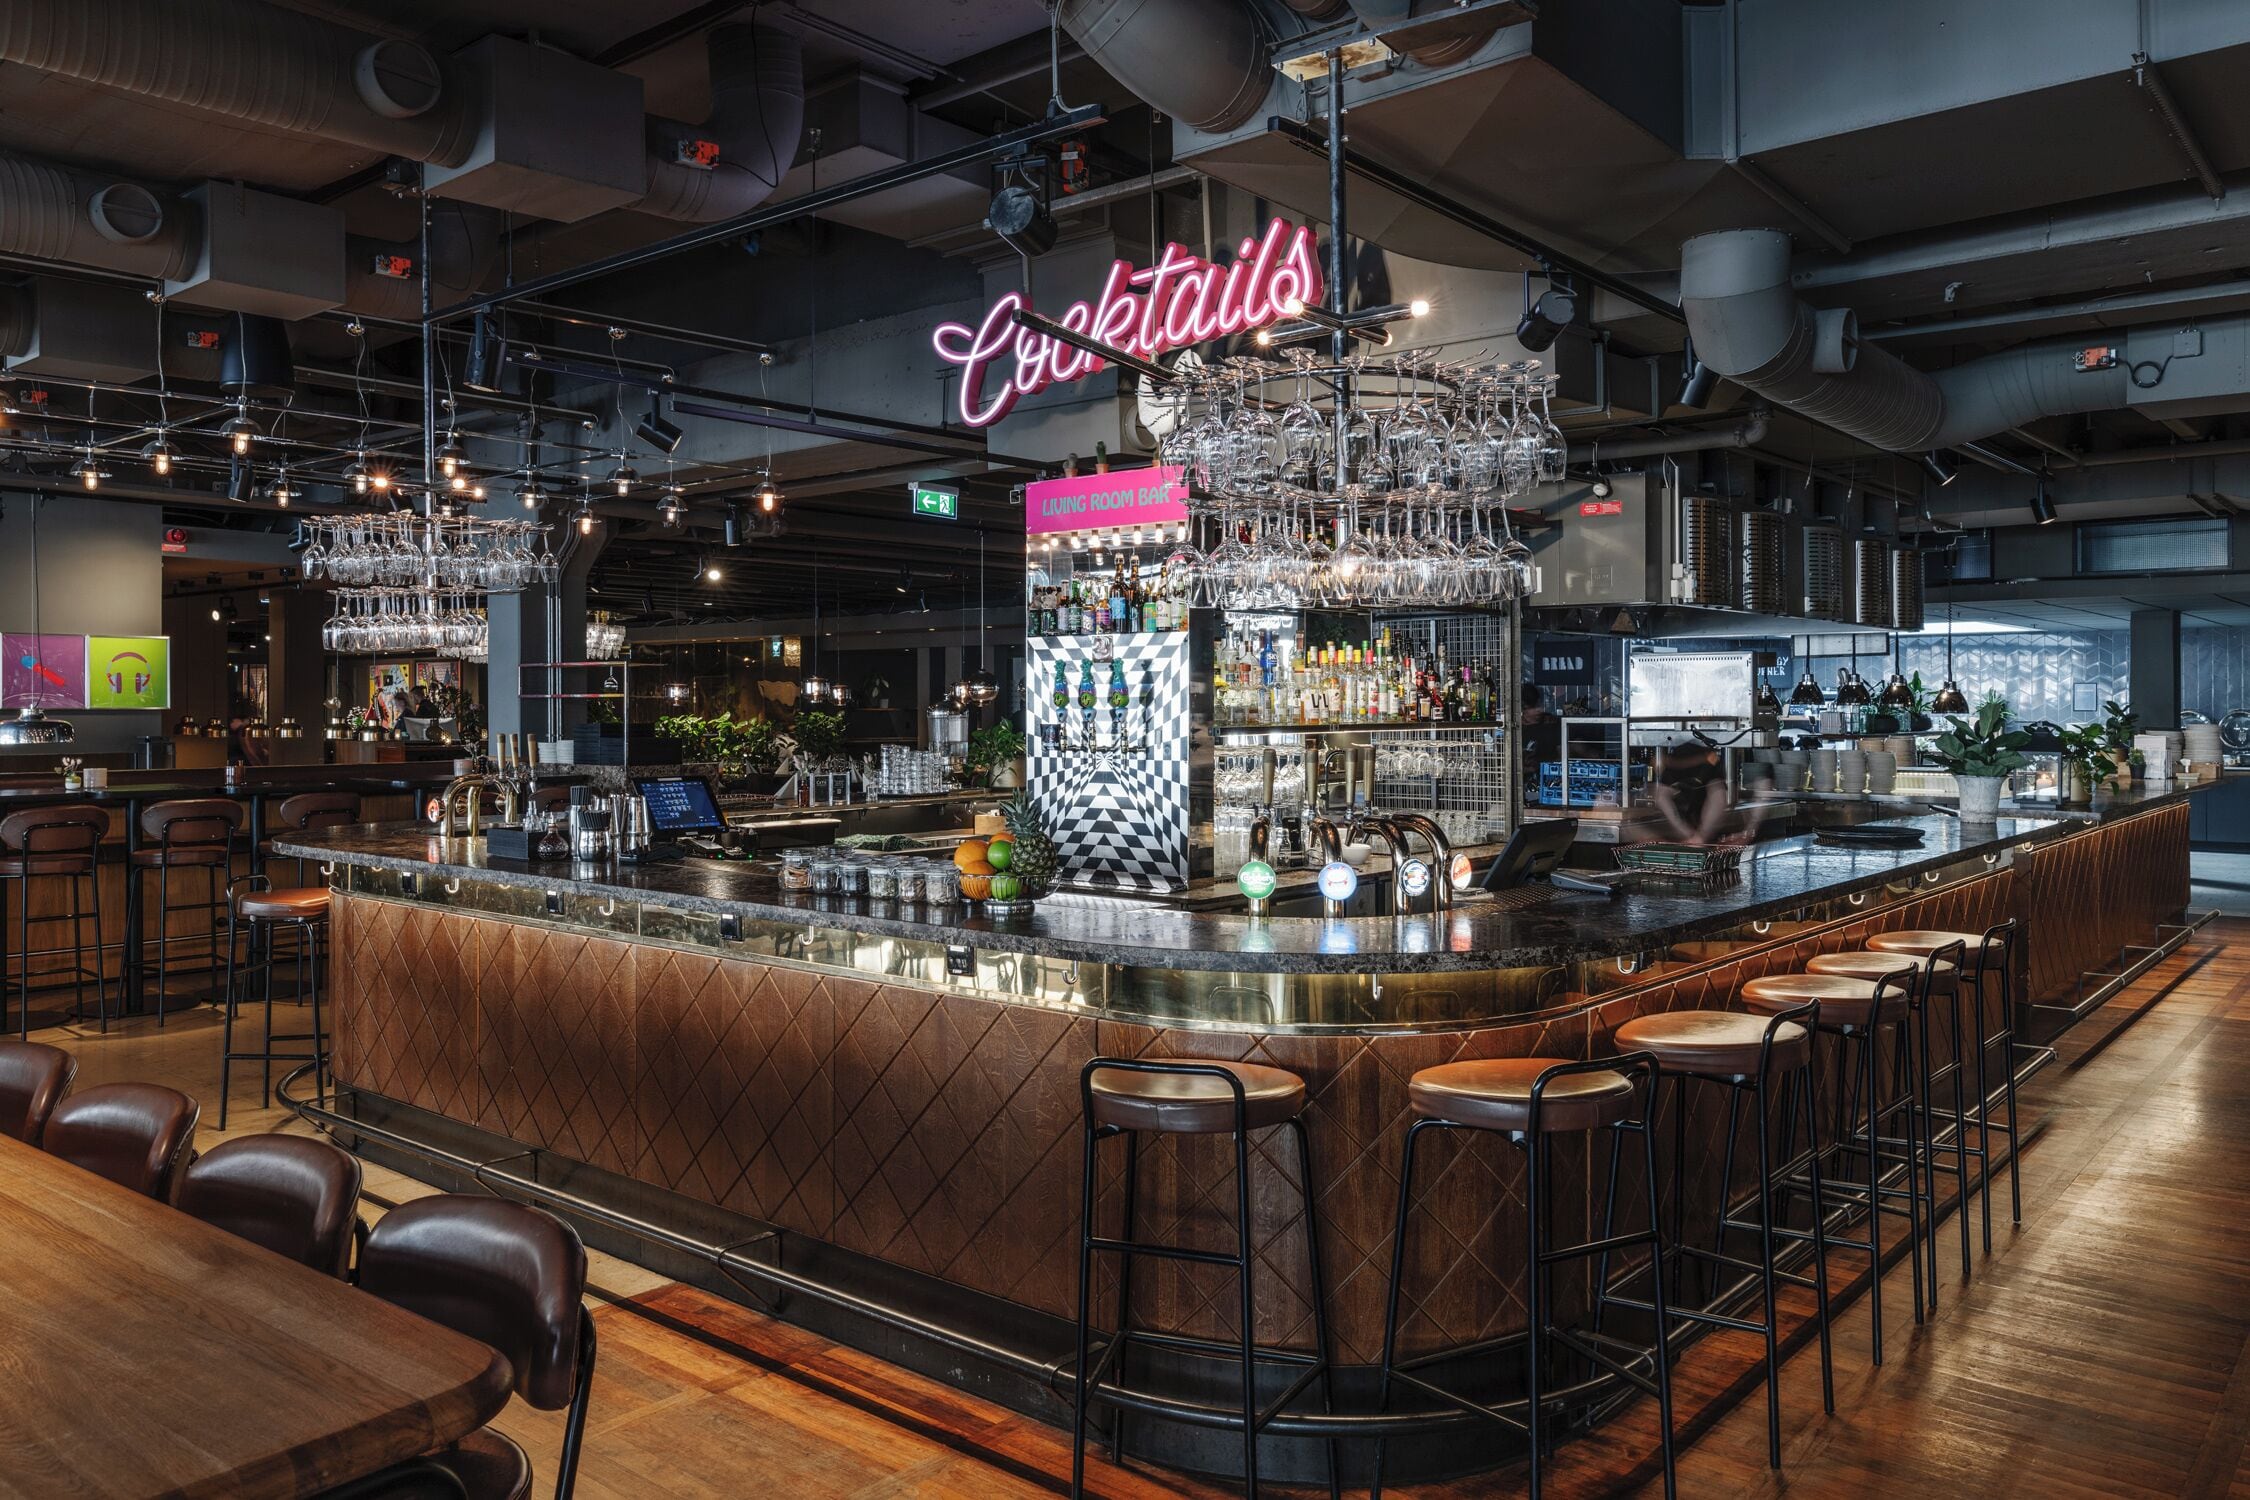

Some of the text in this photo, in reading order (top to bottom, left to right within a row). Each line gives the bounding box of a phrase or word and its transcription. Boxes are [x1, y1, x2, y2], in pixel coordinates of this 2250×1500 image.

[932, 217, 1323, 428] Cocktails
[1042, 485, 1170, 517] LIVING ROOM BAR
[1542, 656, 1584, 671] BREAD
